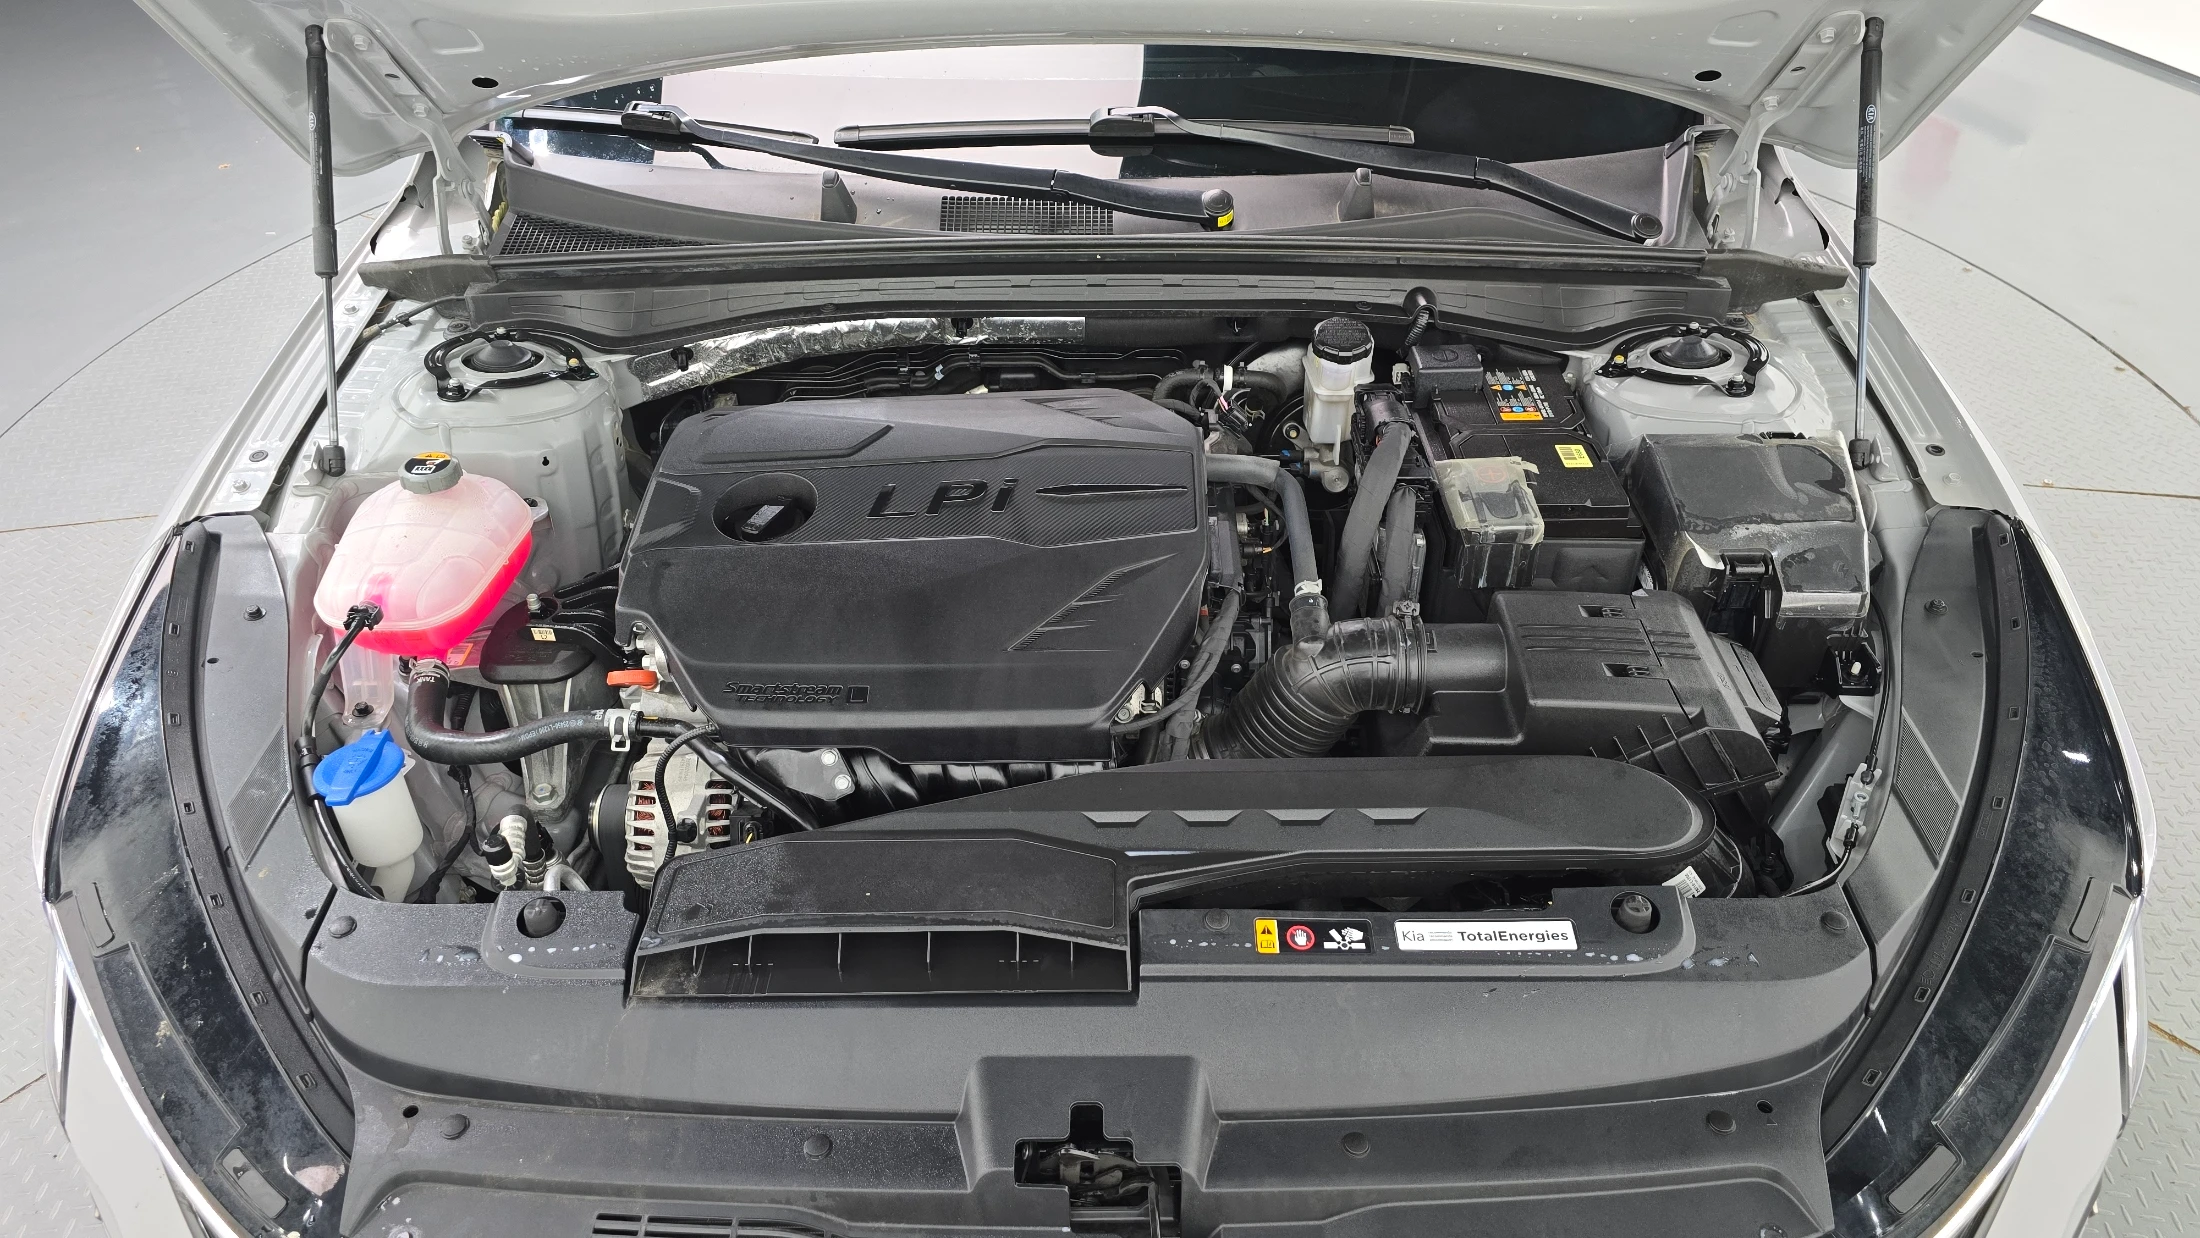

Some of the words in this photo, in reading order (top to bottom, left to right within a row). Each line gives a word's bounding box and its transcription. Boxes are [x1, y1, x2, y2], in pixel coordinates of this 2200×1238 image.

[866, 477, 1020, 518] LPi
[416, 676, 436, 684] TANK
[723, 681, 844, 695] Smartstream
[736, 694, 841, 704] TECHNOLOGY
[1402, 930, 1425, 942] Kia
[1457, 930, 1569, 943] TotalEnergies
